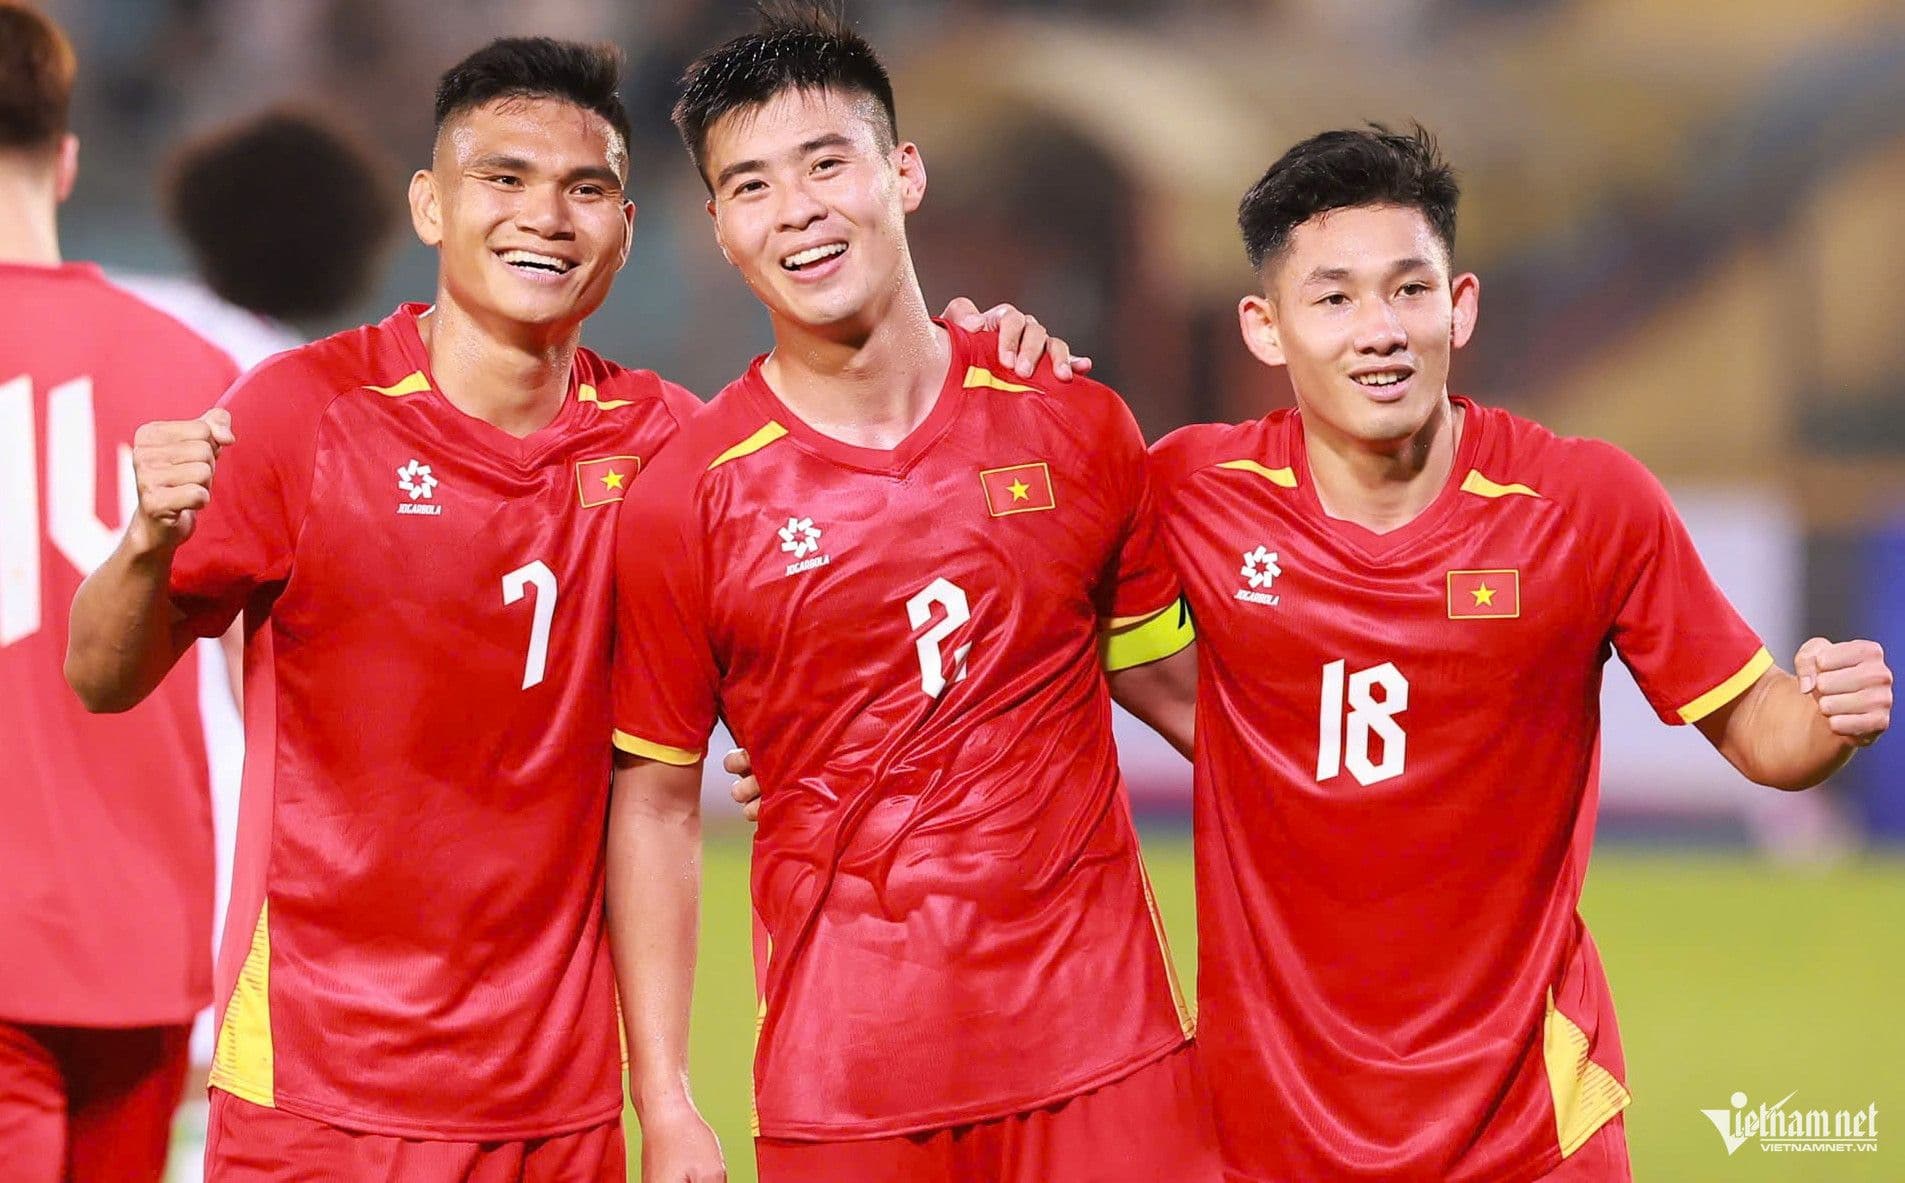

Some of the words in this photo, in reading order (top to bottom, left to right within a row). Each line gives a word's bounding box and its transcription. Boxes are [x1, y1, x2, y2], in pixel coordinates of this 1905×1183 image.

[501, 559, 558, 691] 7
[905, 576, 973, 699] 2
[1316, 658, 1409, 786] 18
